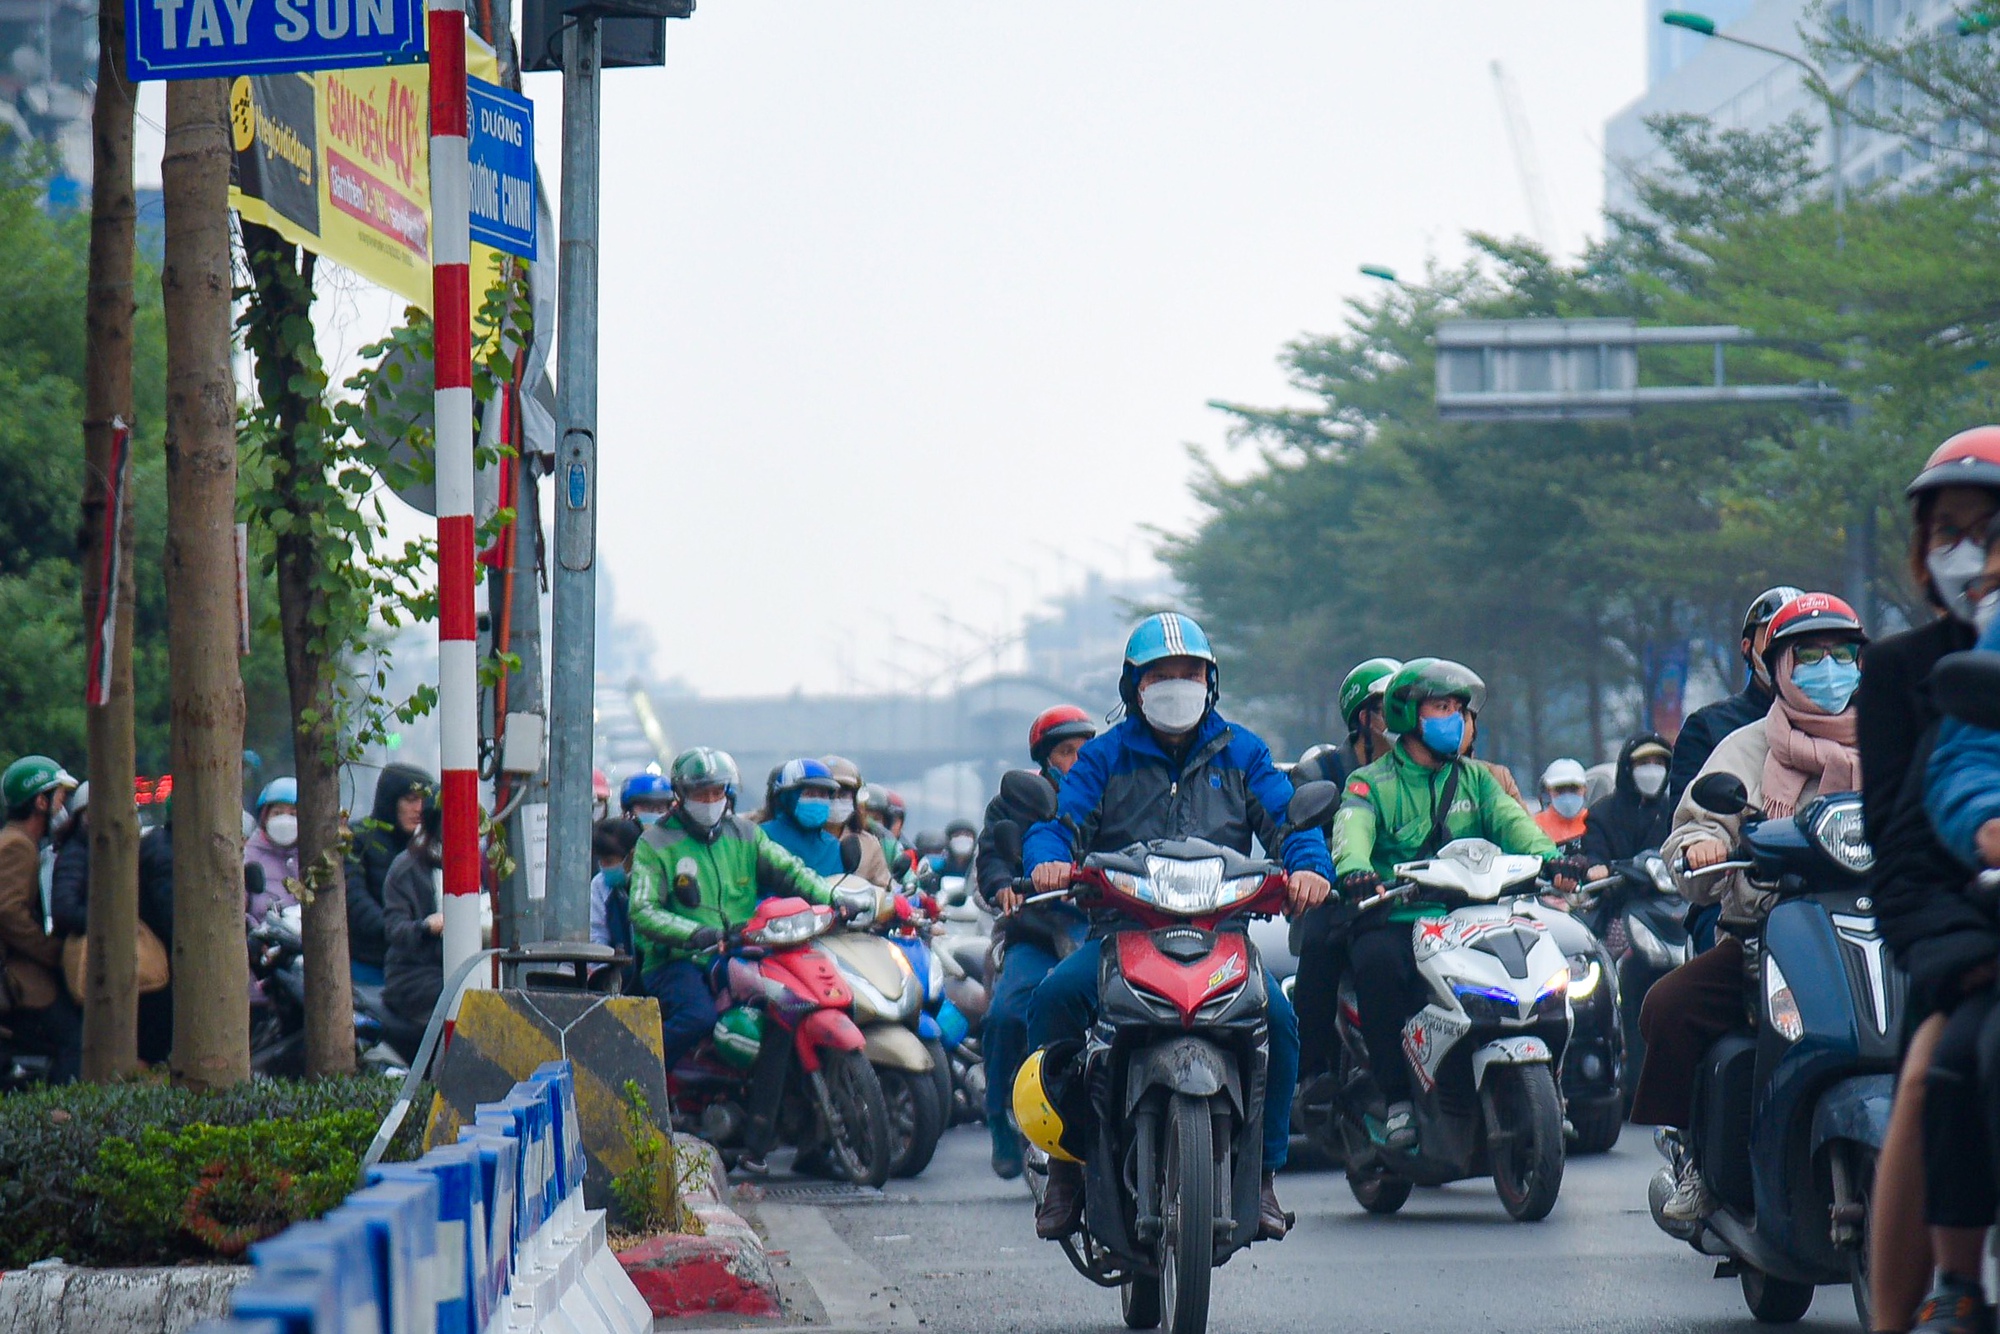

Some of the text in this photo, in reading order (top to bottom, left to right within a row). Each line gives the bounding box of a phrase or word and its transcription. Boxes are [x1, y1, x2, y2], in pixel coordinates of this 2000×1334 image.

[481, 106, 522, 148] ĐƯỜNG
[468, 153, 530, 232] RƯỜNG CHINH
[1166, 929, 1203, 941] HONDA
